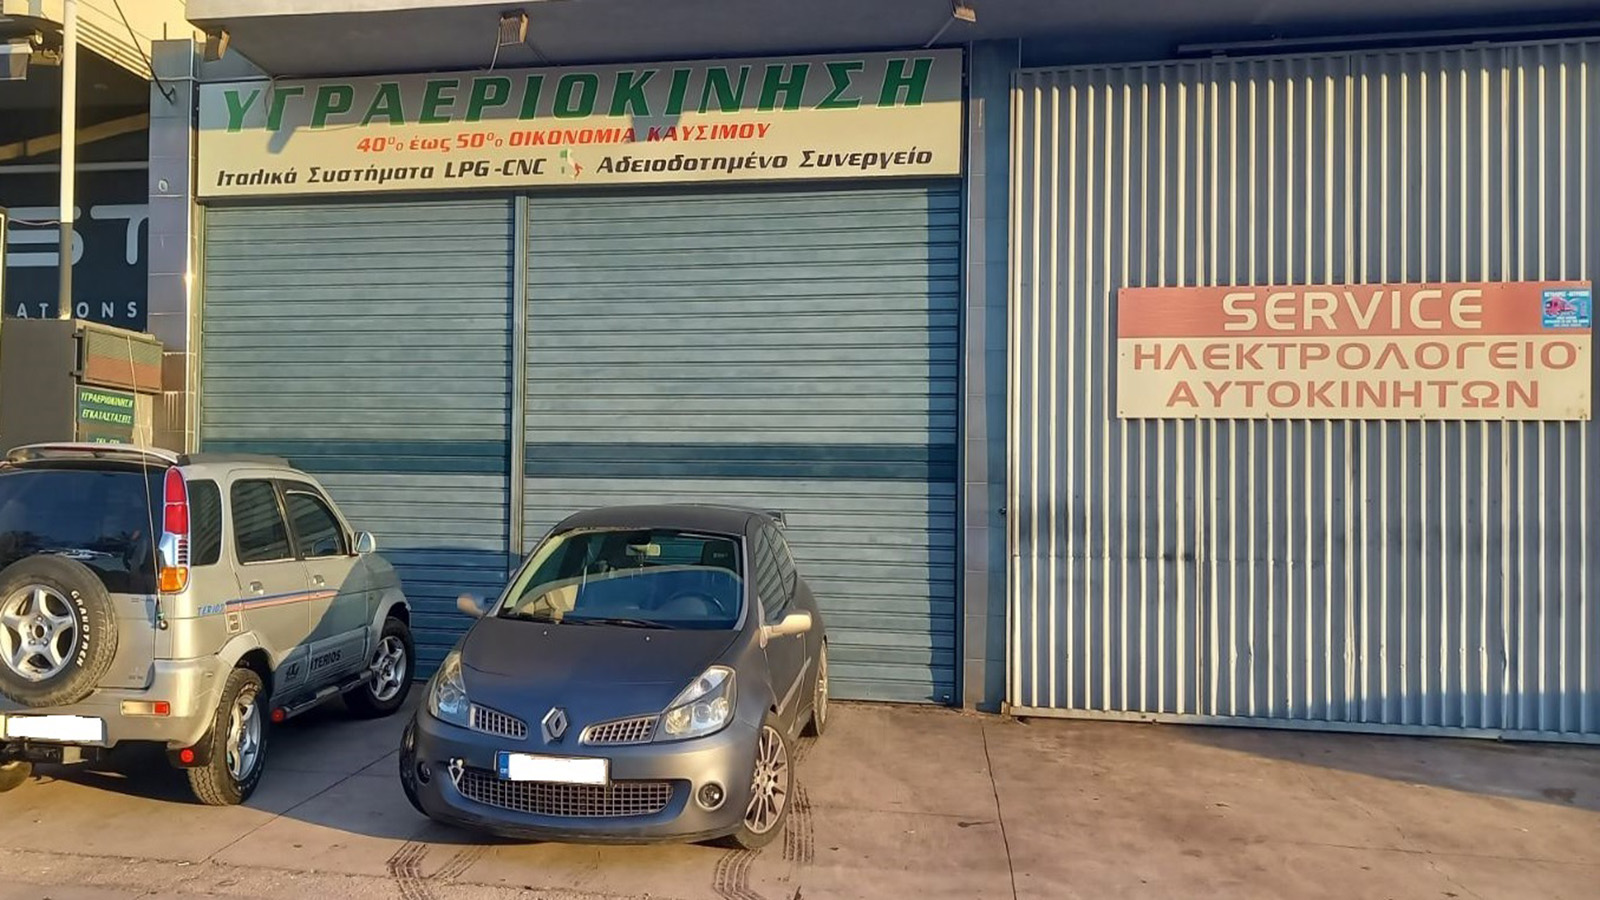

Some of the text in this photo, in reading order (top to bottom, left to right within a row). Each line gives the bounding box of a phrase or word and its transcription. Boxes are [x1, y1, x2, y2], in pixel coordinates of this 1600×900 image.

[222, 57, 935, 133] ΥΓΡΑΕΡΙΟΚΙΝΗΣΗ
[408, 135, 452, 153] έως
[508, 126, 636, 148] ΟΙΚΟΝΟΜΙΑ
[646, 122, 771, 143] ΚΑΥΣΙΜΟΥ
[216, 167, 298, 187] Ιταλικά
[306, 163, 434, 185] Συστήματα
[596, 151, 788, 174] Αδειοδοτημένο
[798, 146, 933, 169] Συνεργείο
[16, 301, 138, 319] ATONS
[1221, 289, 1483, 332] SERVICE
[1134, 341, 1578, 371] ΗΛΕΚΤΡΟΛΟΓΕΙΟ
[1165, 380, 1540, 409] ΑΥΤΟΚΙΝΗΤΩΝ
